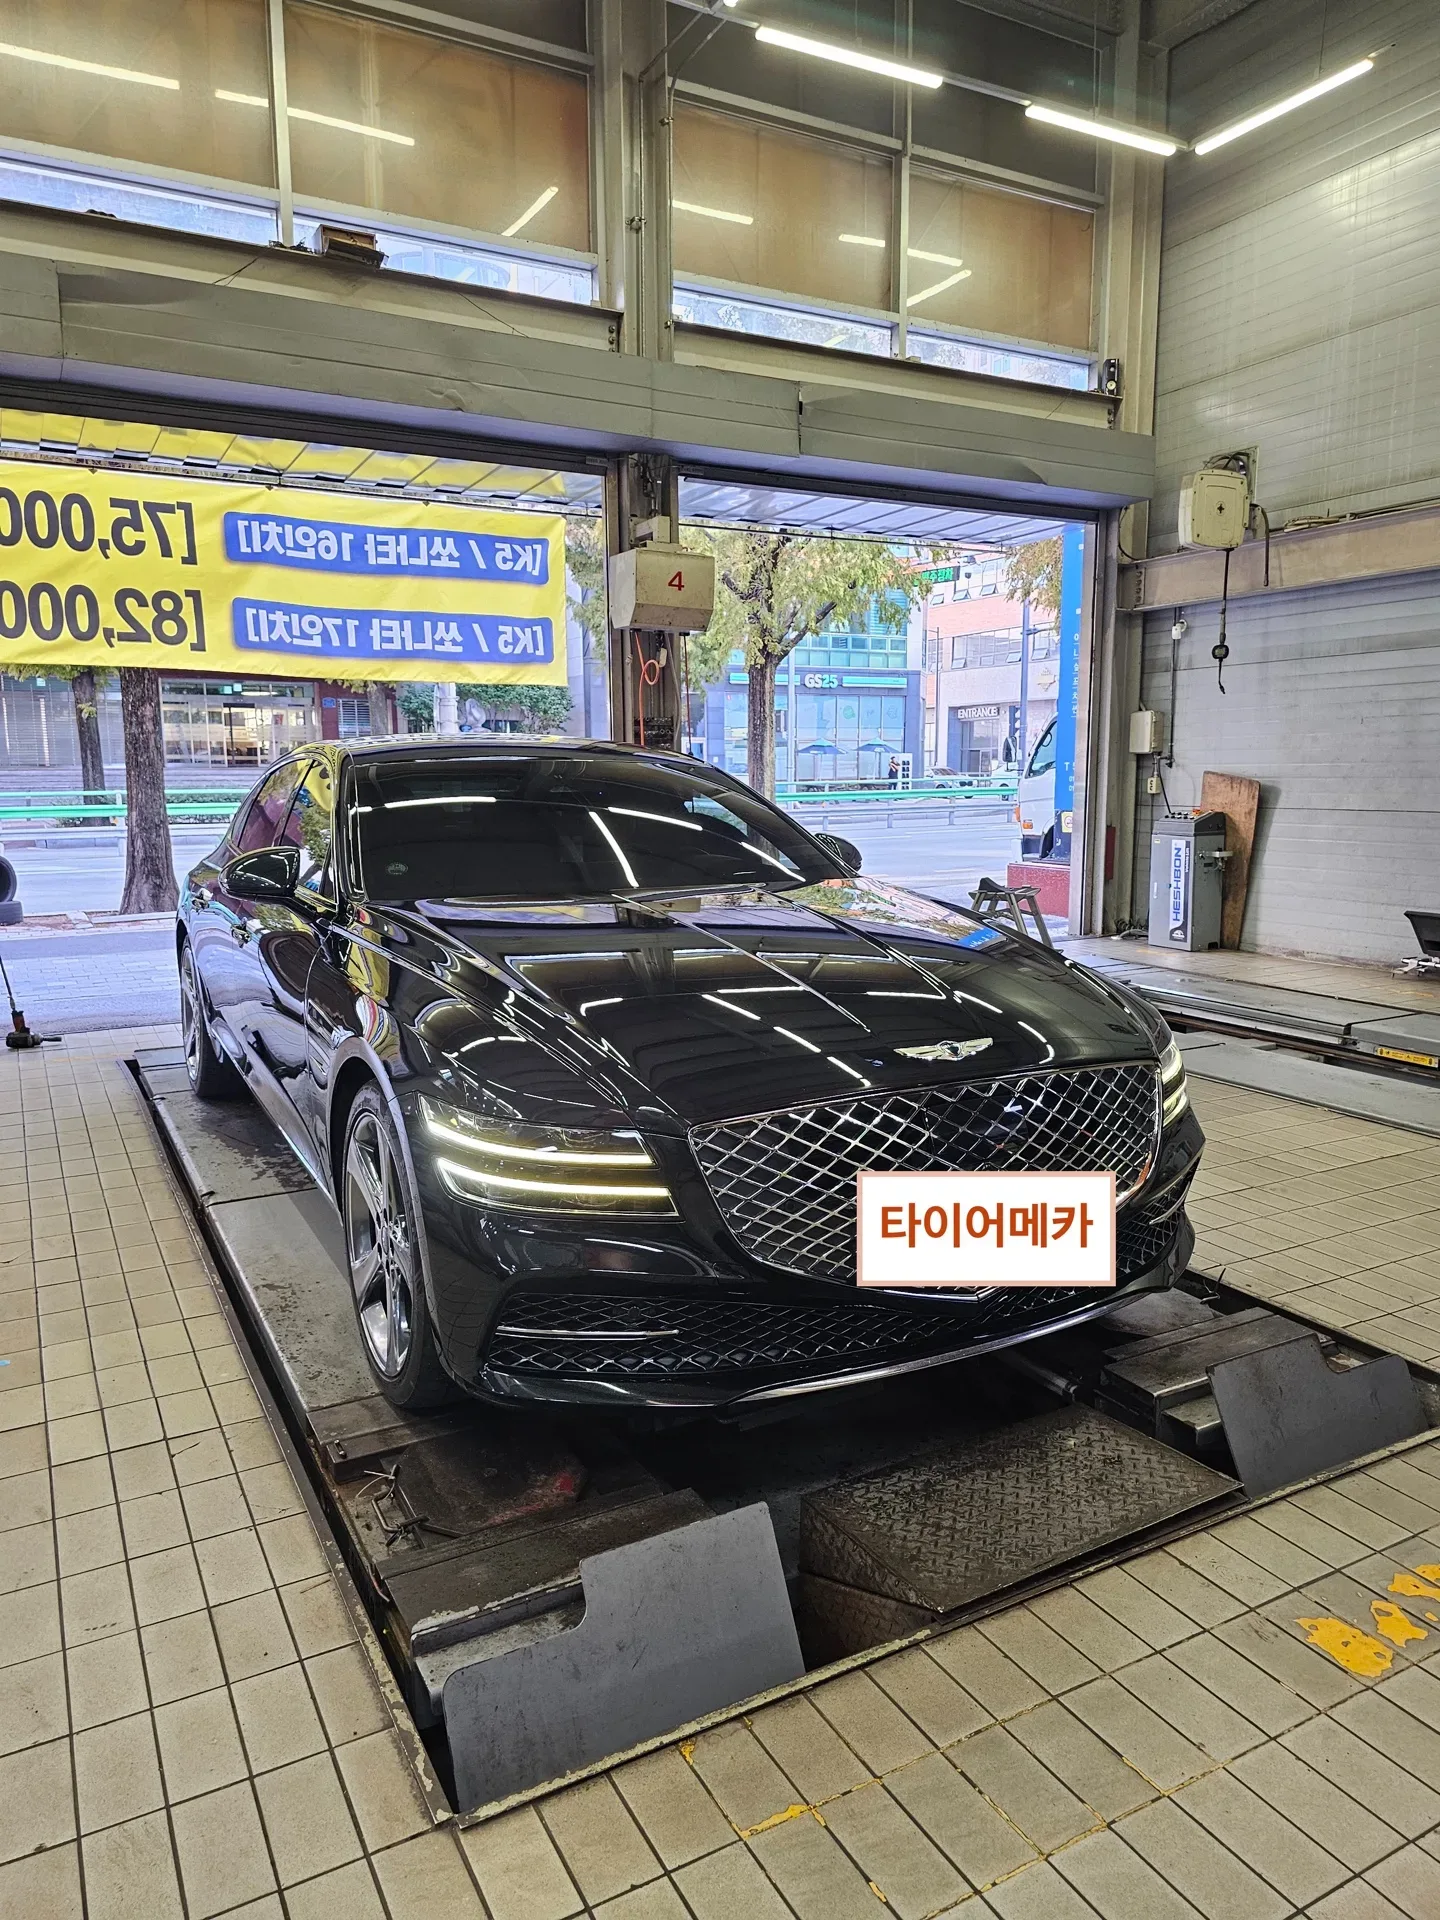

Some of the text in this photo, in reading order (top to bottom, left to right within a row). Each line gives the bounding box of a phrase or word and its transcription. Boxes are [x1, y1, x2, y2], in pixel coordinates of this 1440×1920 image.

[667, 571, 685, 591] 4
[804, 673, 838, 689] GS25
[957, 706, 998, 719] ENTRANCE
[1173, 847, 1182, 921] HESHBON
